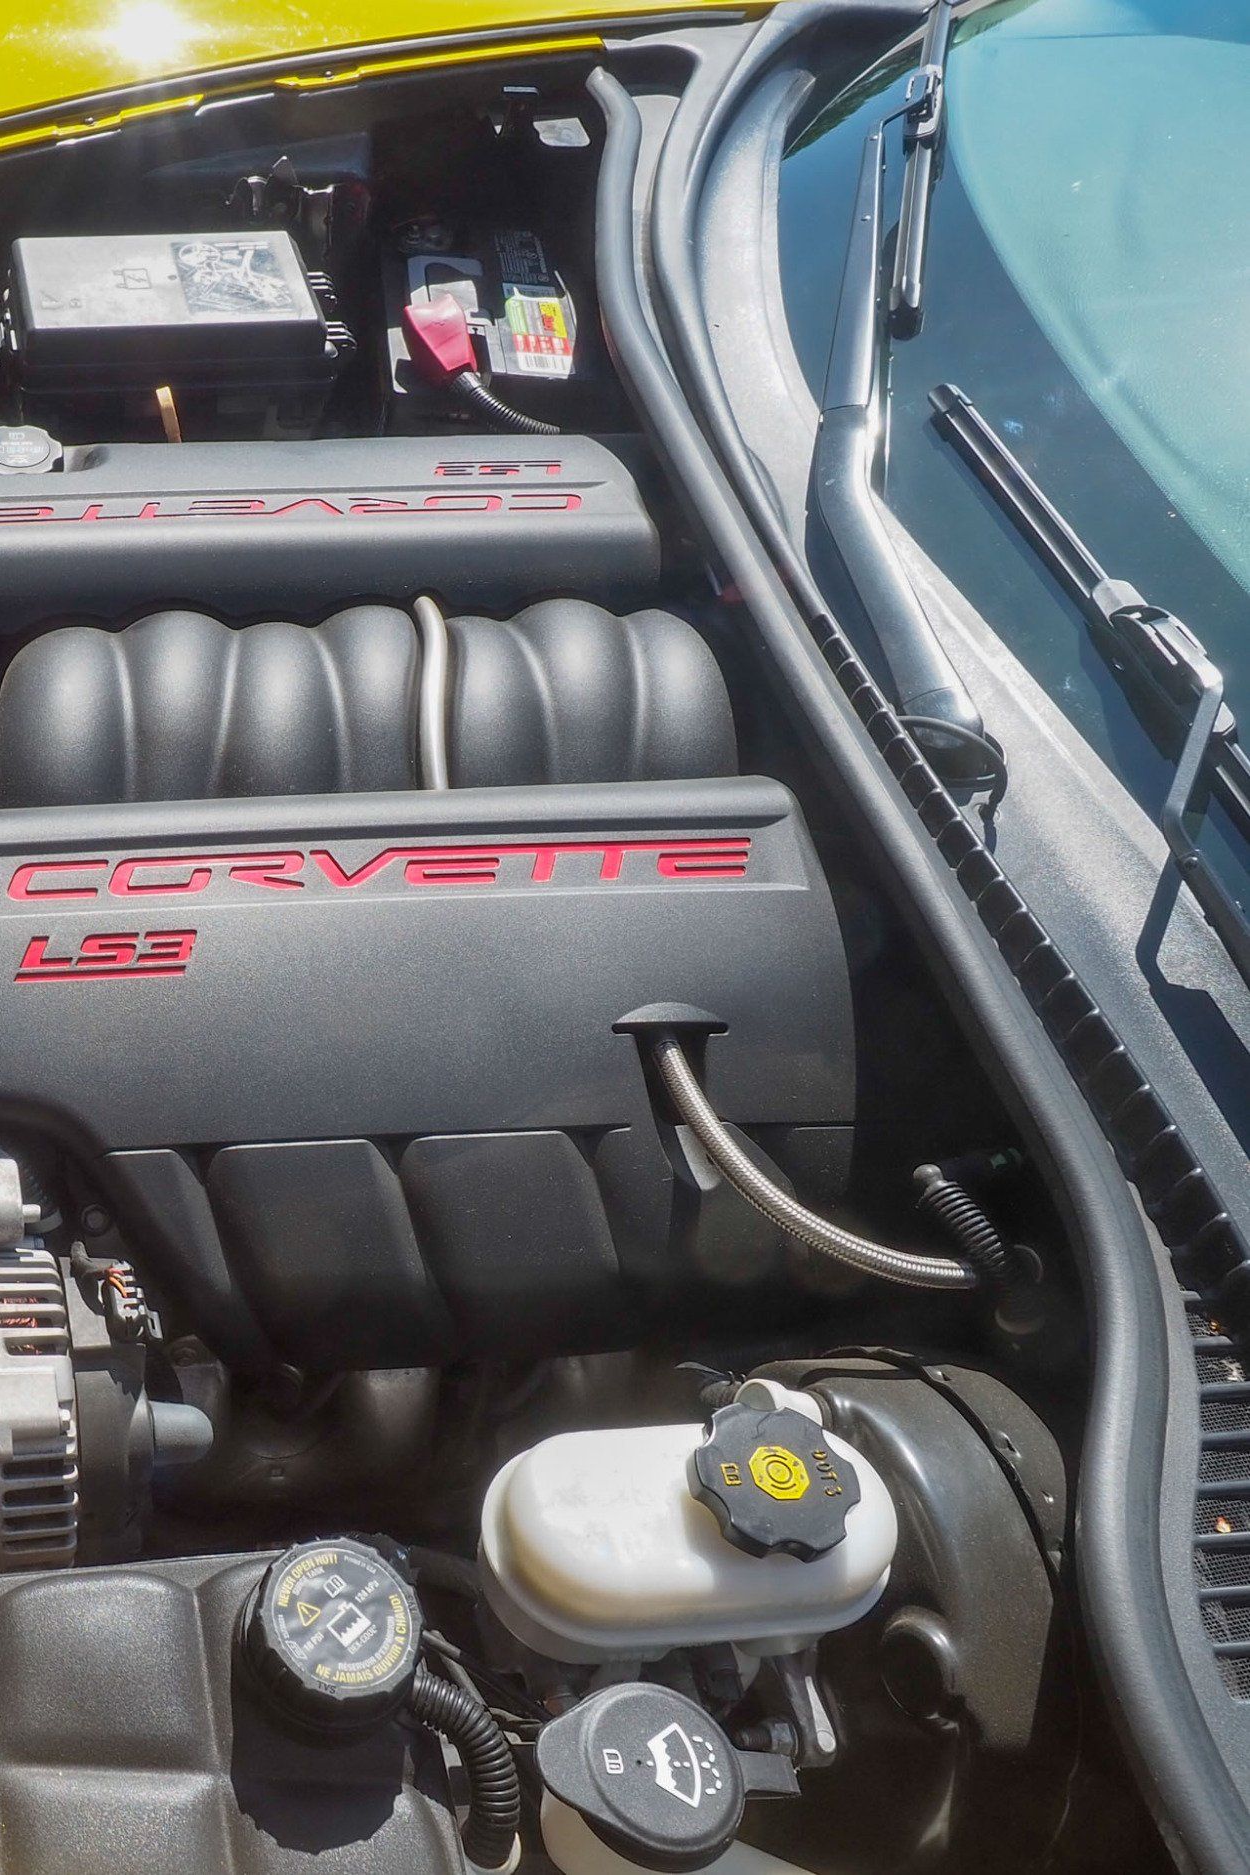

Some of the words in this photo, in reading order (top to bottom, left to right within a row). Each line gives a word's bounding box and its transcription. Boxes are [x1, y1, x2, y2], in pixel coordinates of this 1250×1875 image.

[435, 464, 561, 476] LS3
[7, 838, 752, 902] CORVETTE
[19, 929, 197, 971] LS3
[810, 1449, 838, 1482] DOT
[824, 1485, 843, 1497] 3
[277, 1576, 296, 1608] NEVER
[291, 1558, 316, 1579] OPEN
[314, 1553, 339, 1566] HOT!
[310, 1631, 325, 1644] PSI
[315, 1663, 332, 1679] NE
[332, 1669, 374, 1684] JAMAIS
[373, 1645, 403, 1676] OUVRIR
[388, 1593, 407, 1635] CHAUD!
[316, 1680, 337, 1695] TVS
